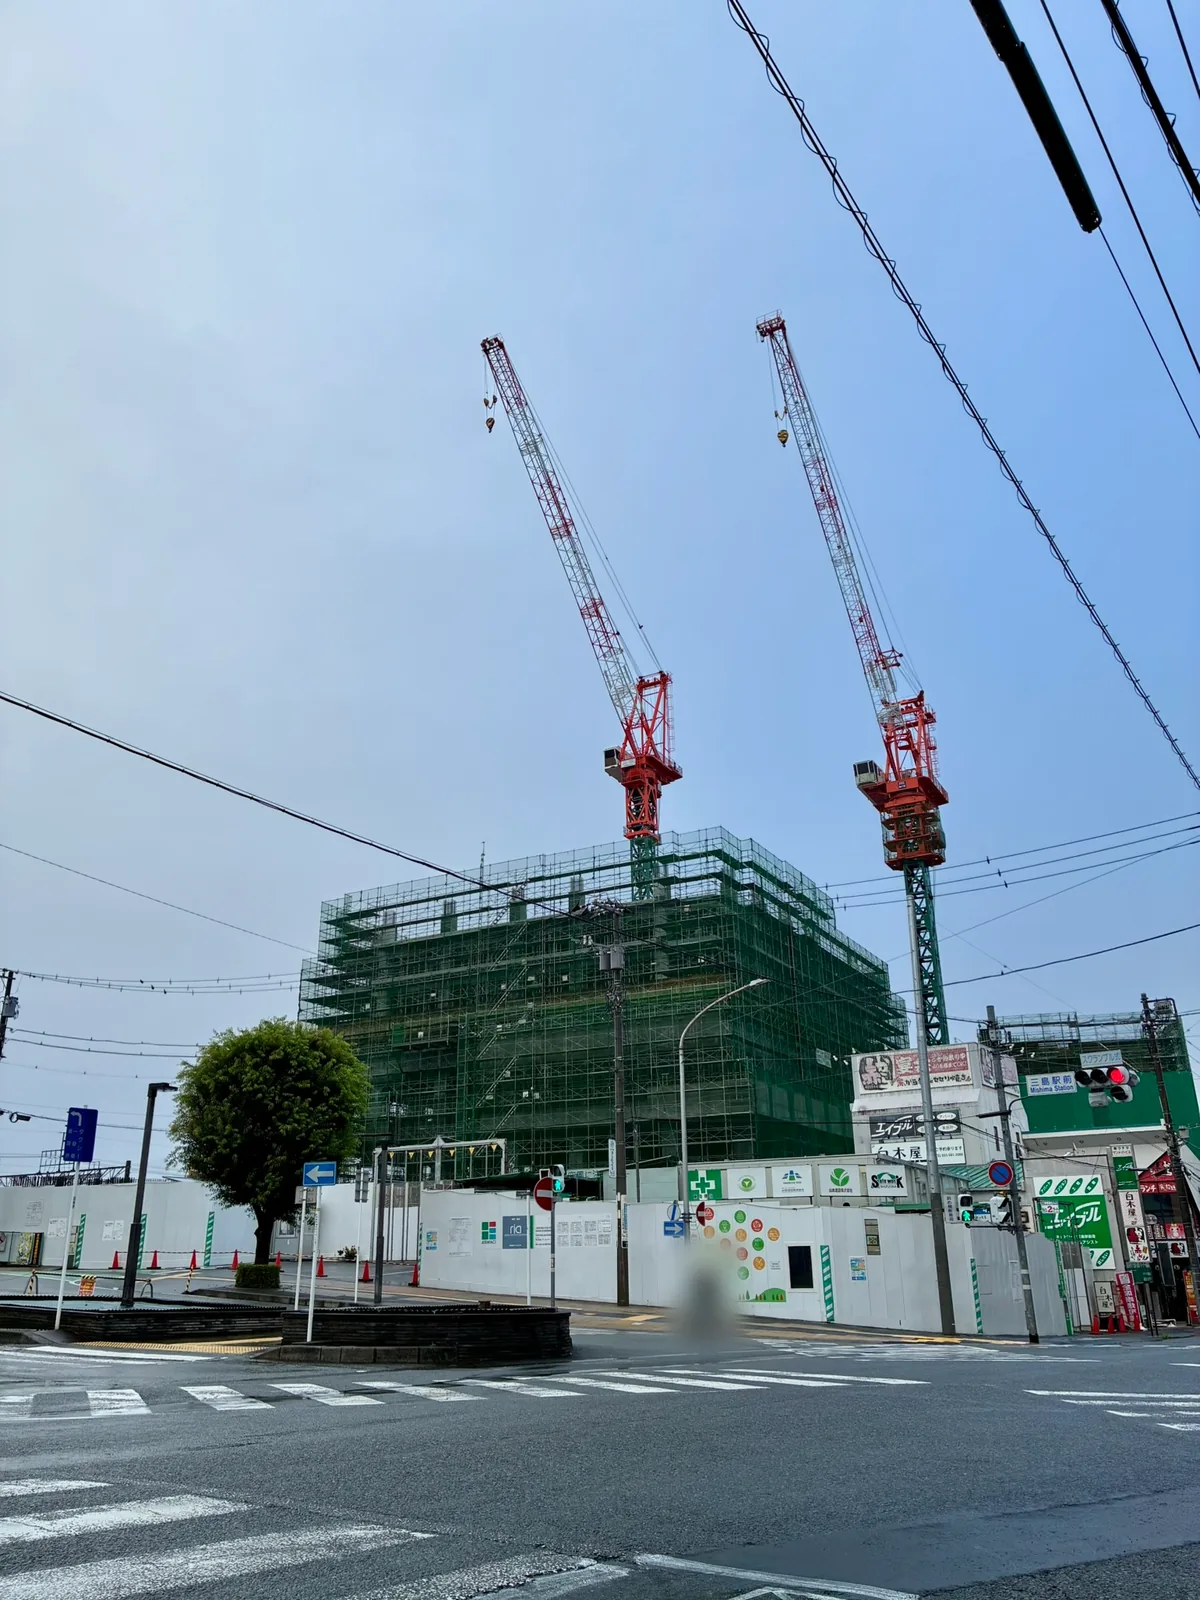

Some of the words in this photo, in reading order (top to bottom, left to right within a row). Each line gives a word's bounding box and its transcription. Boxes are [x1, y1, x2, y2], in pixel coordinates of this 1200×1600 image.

[1031, 1075, 1073, 1086] 三島駅前
[1031, 1085, 1053, 1093] Mishima
[1055, 1084, 1074, 1092] Station
[871, 1115, 913, 1137] エイブル
[878, 1146, 923, 1160] 白木屋
[1125, 1191, 1137, 1216] 白木屋
